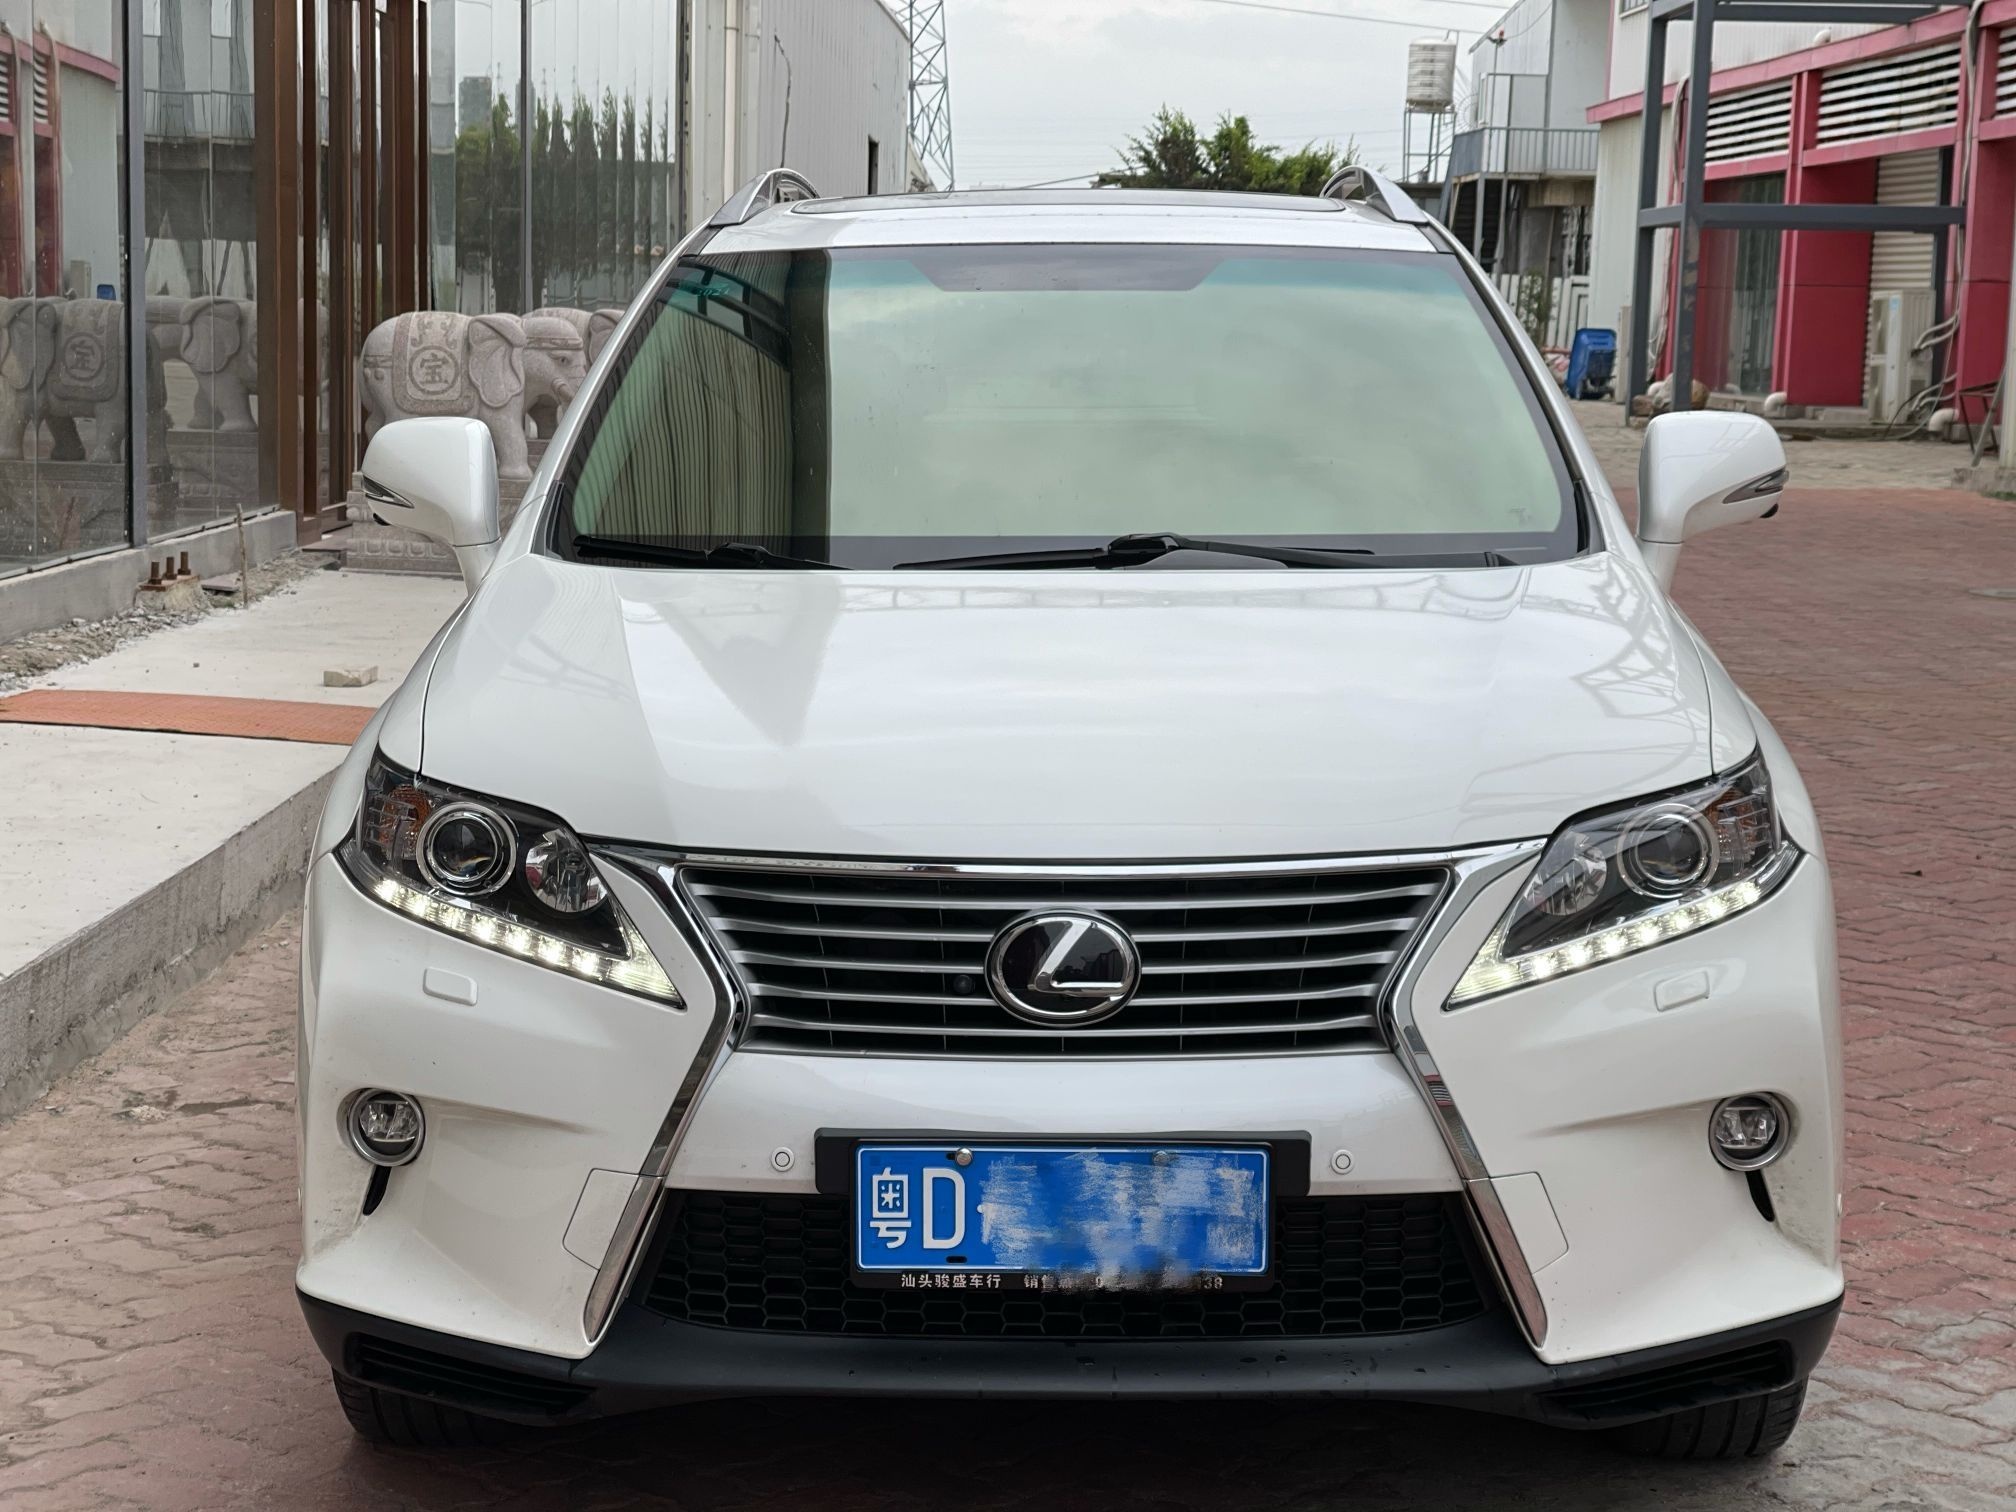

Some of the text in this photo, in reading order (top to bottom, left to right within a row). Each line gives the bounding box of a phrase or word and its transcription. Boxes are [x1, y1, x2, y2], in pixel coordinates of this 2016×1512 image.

[420, 352, 449, 384] 宝
[901, 1273, 1002, 1289] 汕头骏盛车行
